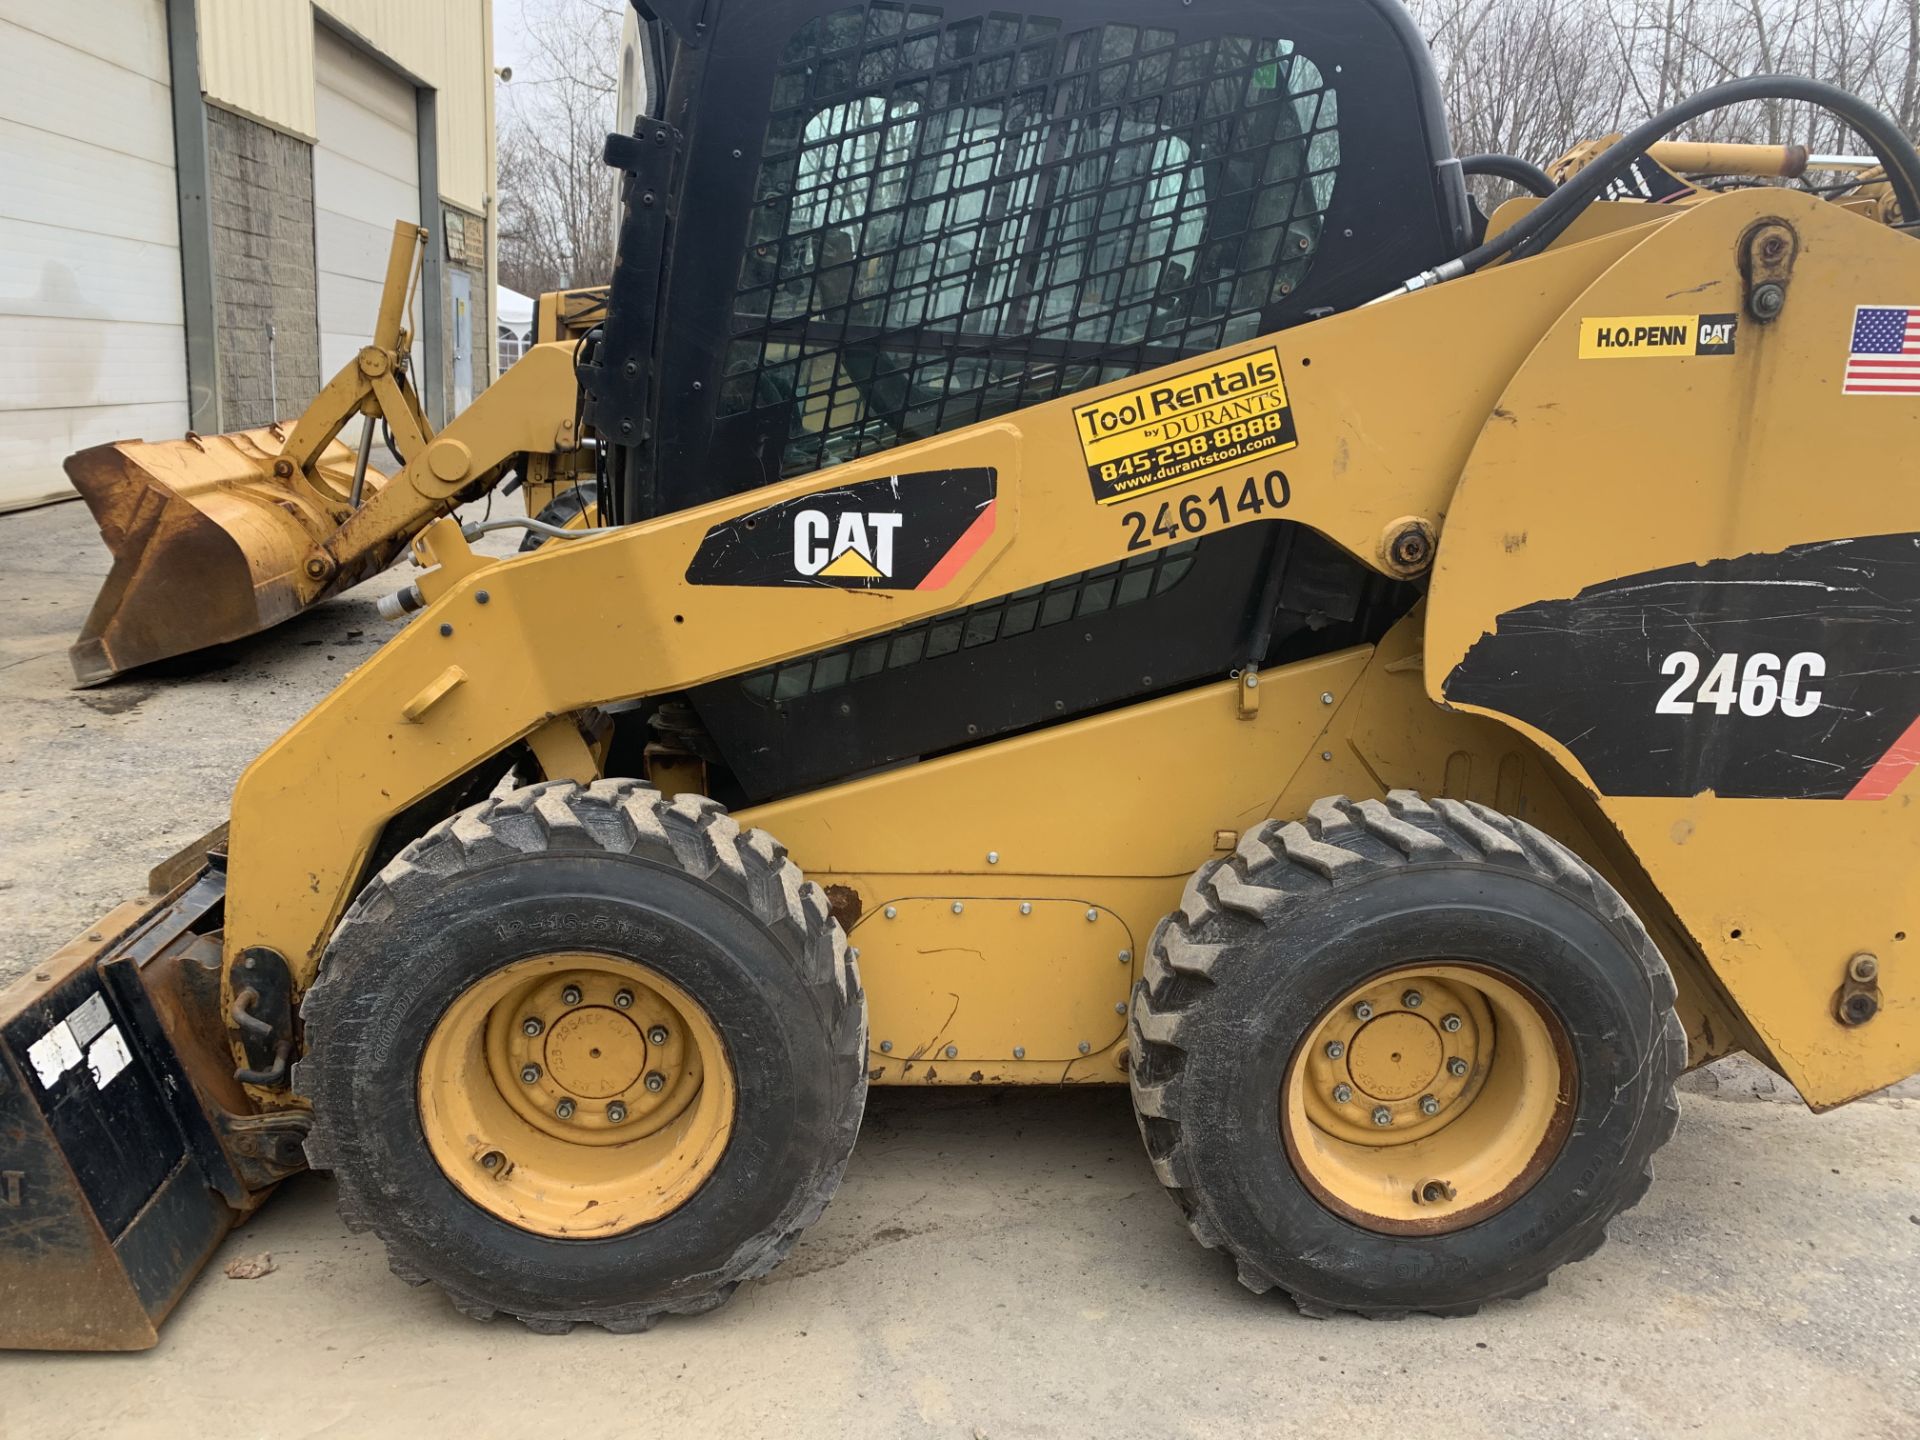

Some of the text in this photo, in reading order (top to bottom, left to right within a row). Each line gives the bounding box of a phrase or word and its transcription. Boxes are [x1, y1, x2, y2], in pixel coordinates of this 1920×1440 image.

[1700, 324, 1735, 345] CAT
[1082, 361, 1276, 437] Tool Rentals
[1144, 389, 1282, 440] by DURANTS
[1114, 435, 1276, 492] www.durantstool.com
[794, 509, 902, 577] CAT
[1121, 470, 1291, 551] 246140
[1655, 651, 1826, 717] 246C
